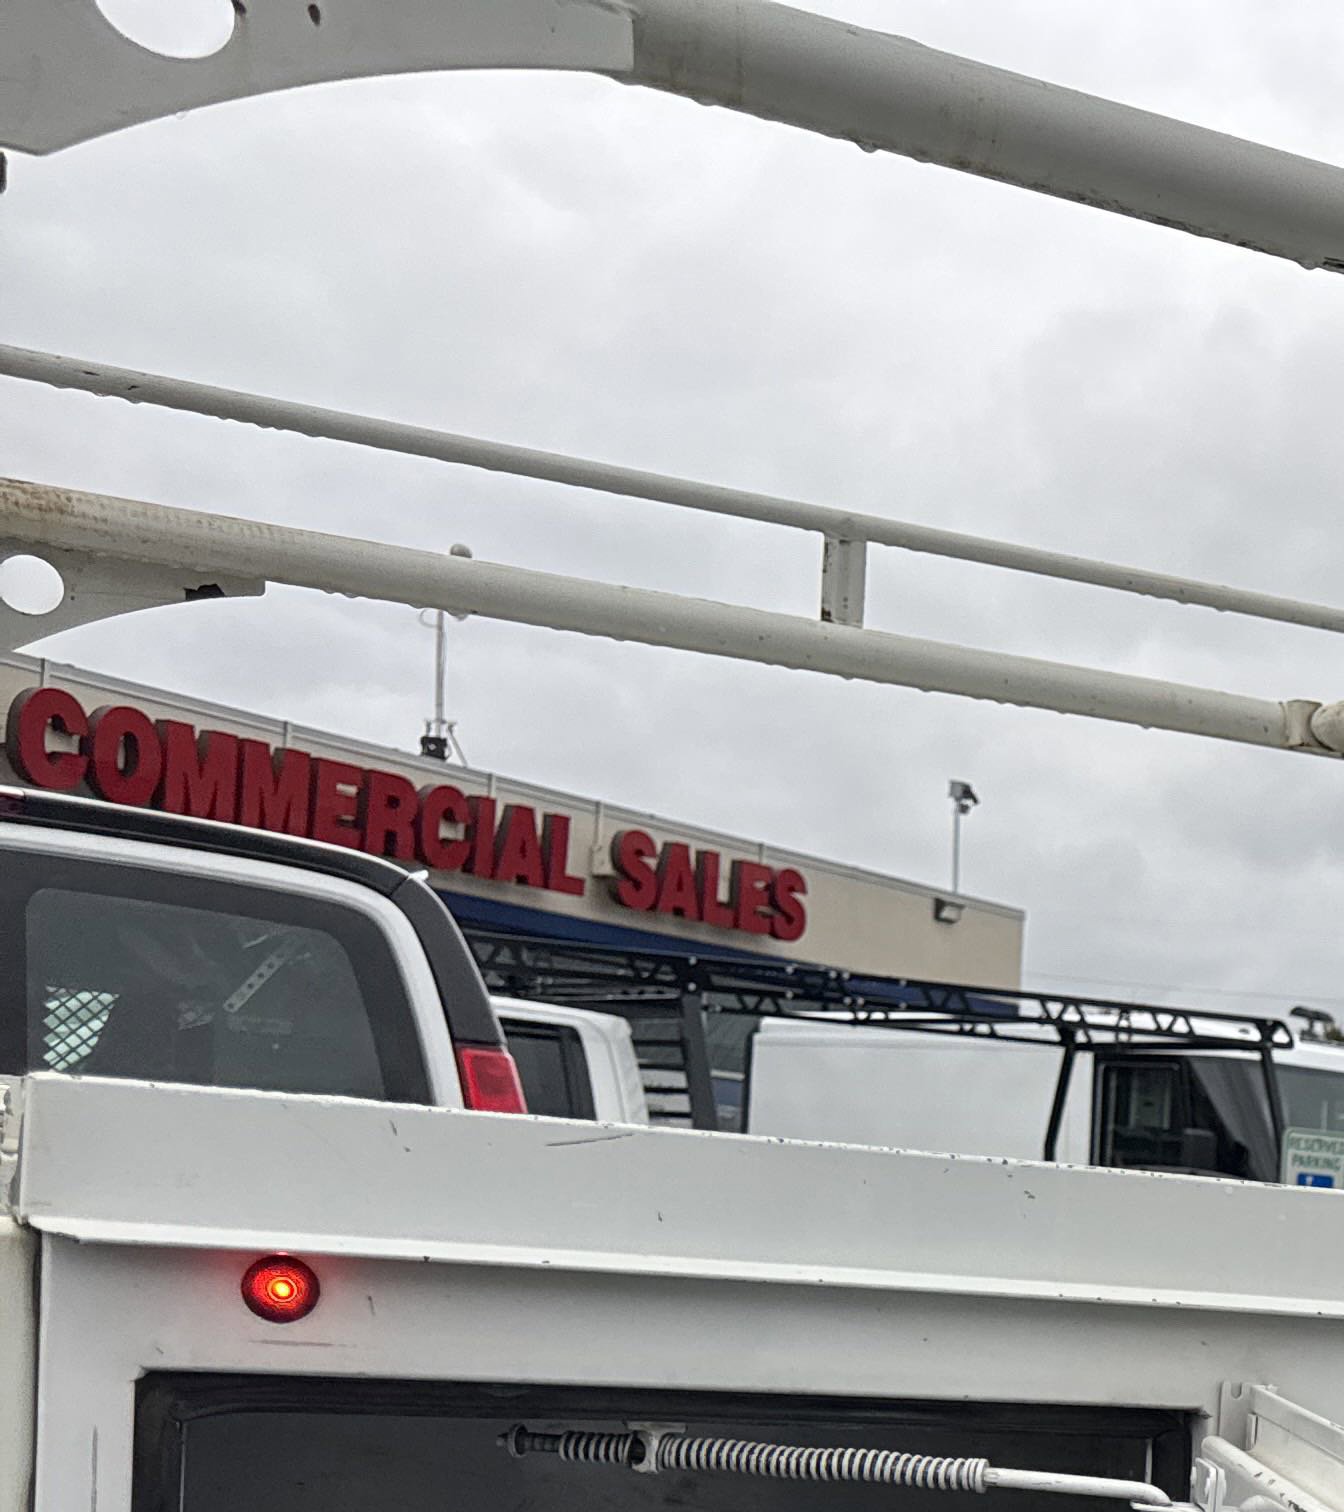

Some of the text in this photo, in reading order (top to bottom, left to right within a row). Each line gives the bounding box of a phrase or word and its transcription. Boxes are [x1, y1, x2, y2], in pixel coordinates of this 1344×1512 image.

[7, 687, 807, 941] COMMERCIAL SALES
[1292, 1154, 1341, 1171] PARKING
